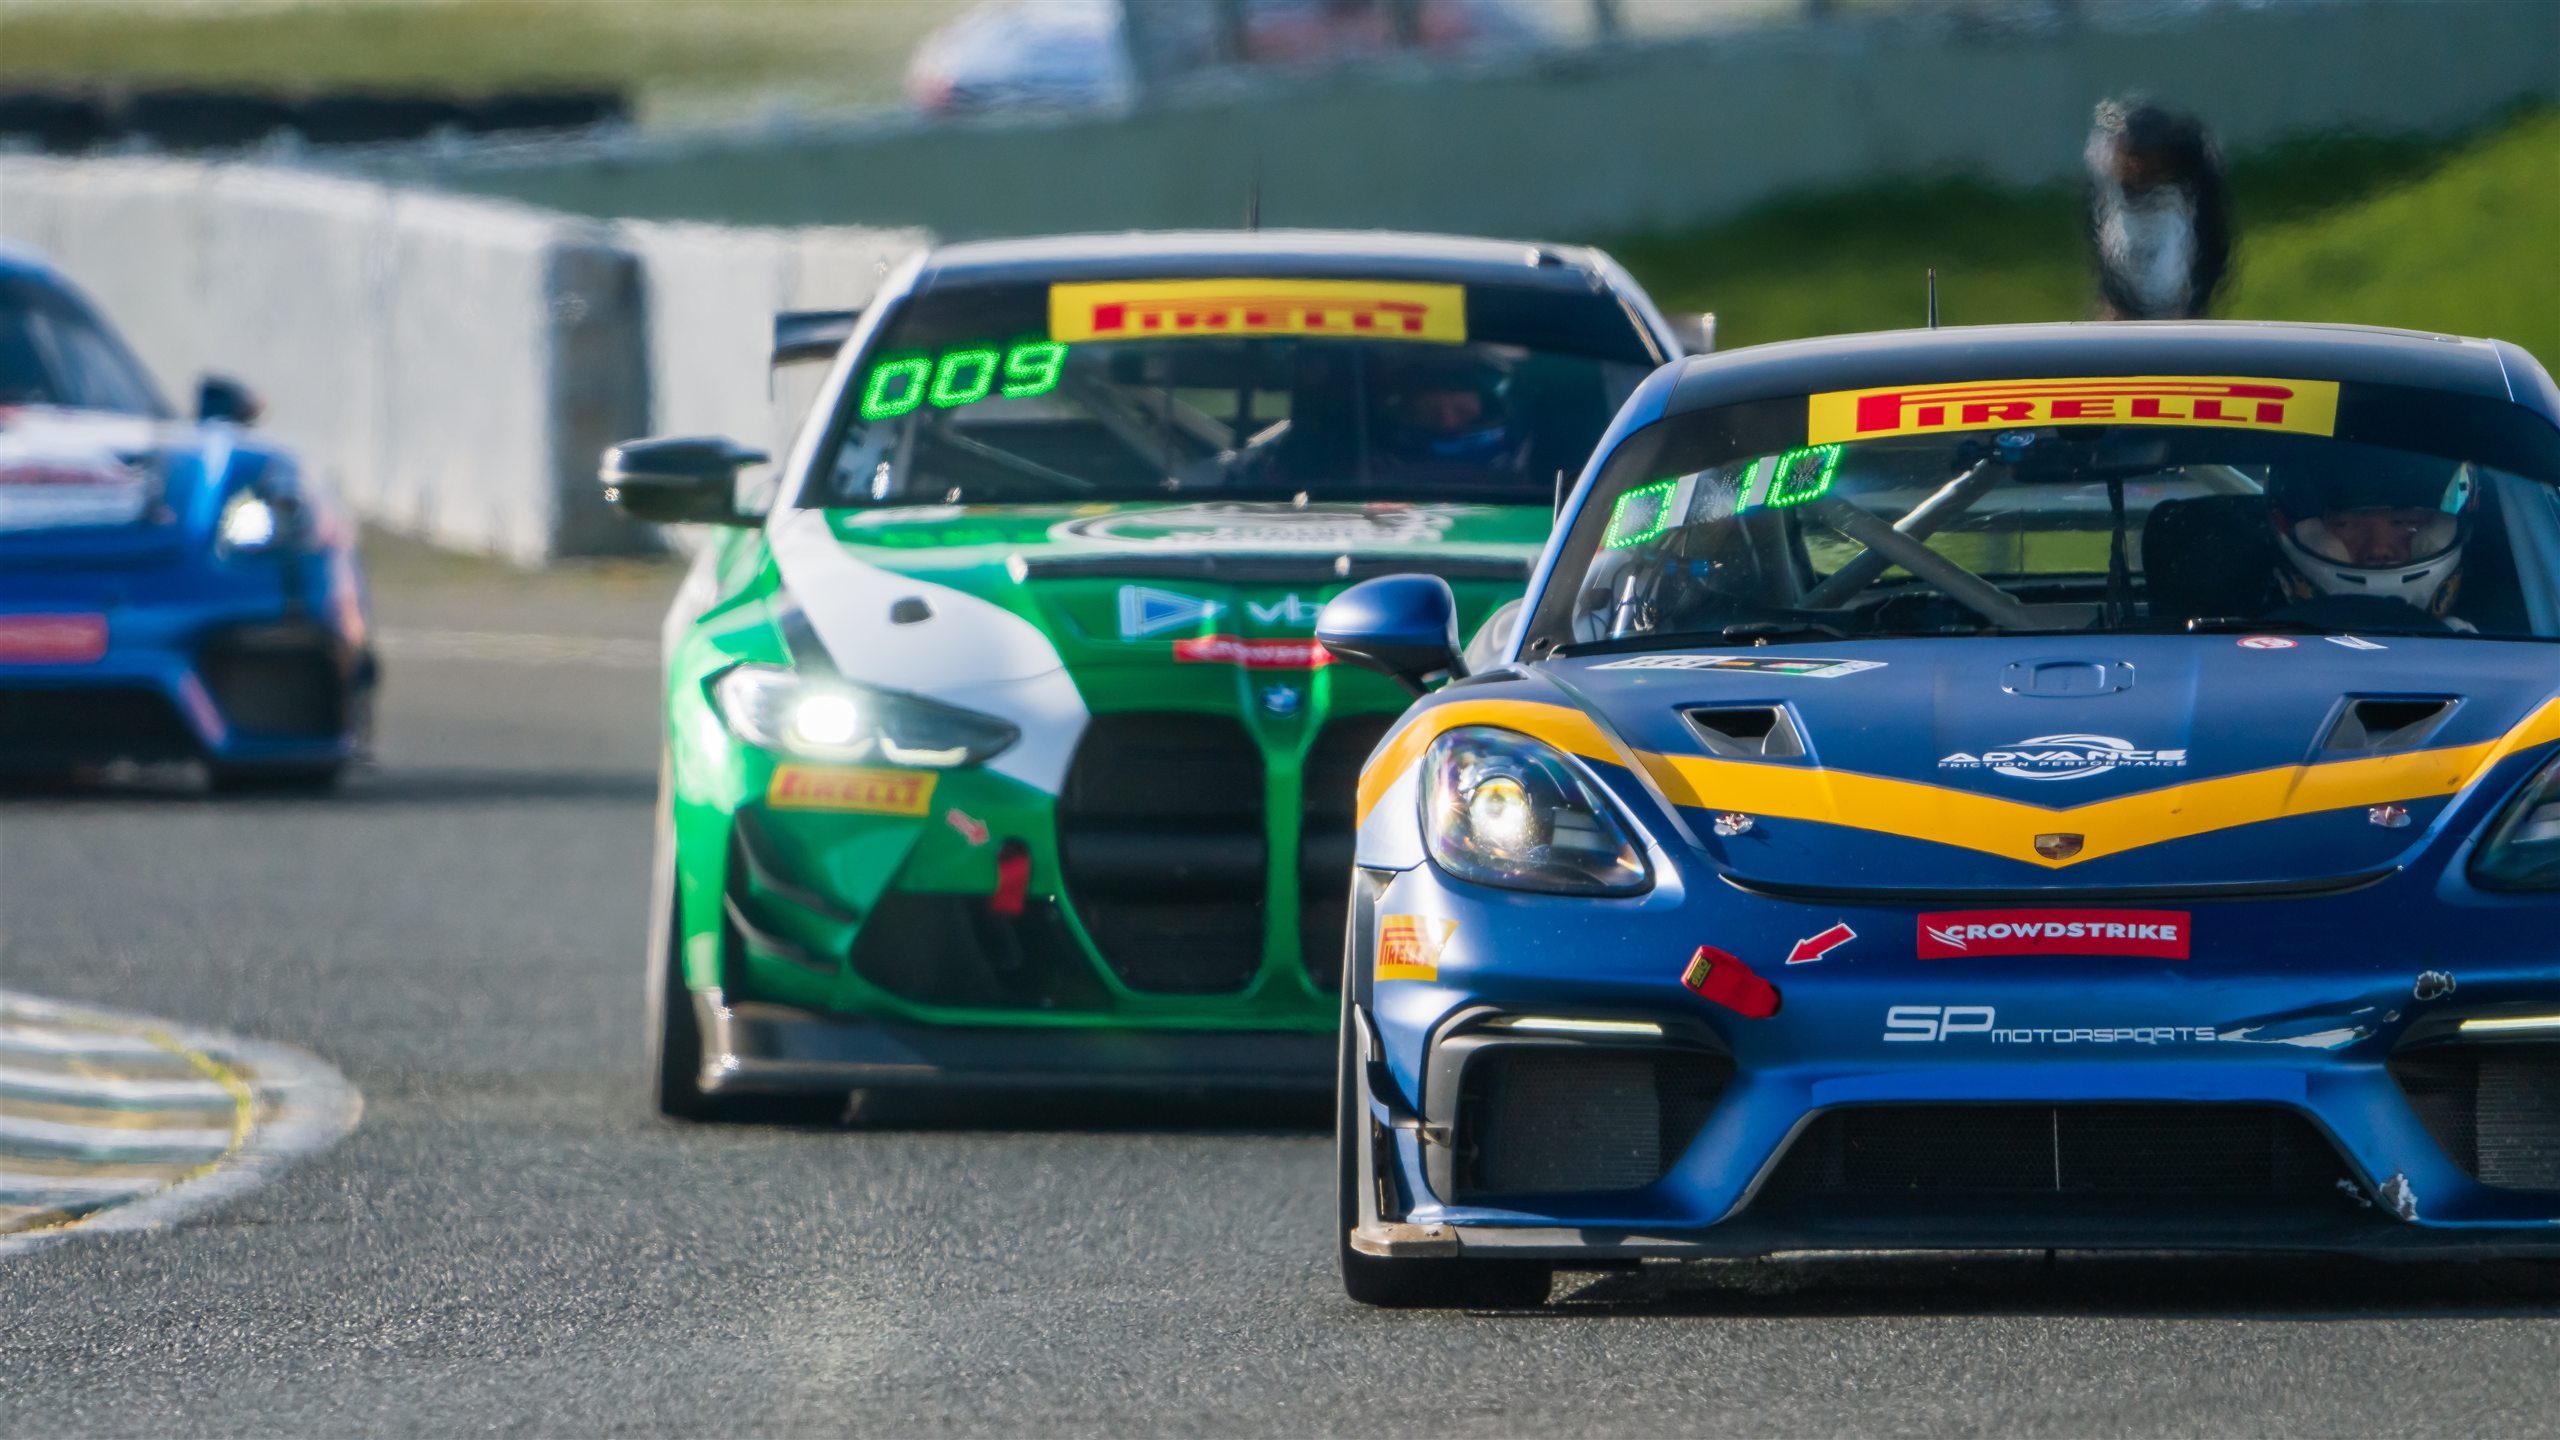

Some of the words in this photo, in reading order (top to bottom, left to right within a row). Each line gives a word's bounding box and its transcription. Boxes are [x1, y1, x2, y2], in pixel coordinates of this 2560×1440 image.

[861, 341, 1071, 420] 009
[1856, 380, 2294, 433] PIRELLI
[1605, 443, 1840, 549] 010
[1938, 760, 2029, 768] FRICTION
[2039, 759, 2188, 767] PERFORMANCE
[1939, 749, 2188, 762] ADVANCE
[1944, 922, 2178, 941] CROWDSTRIKE
